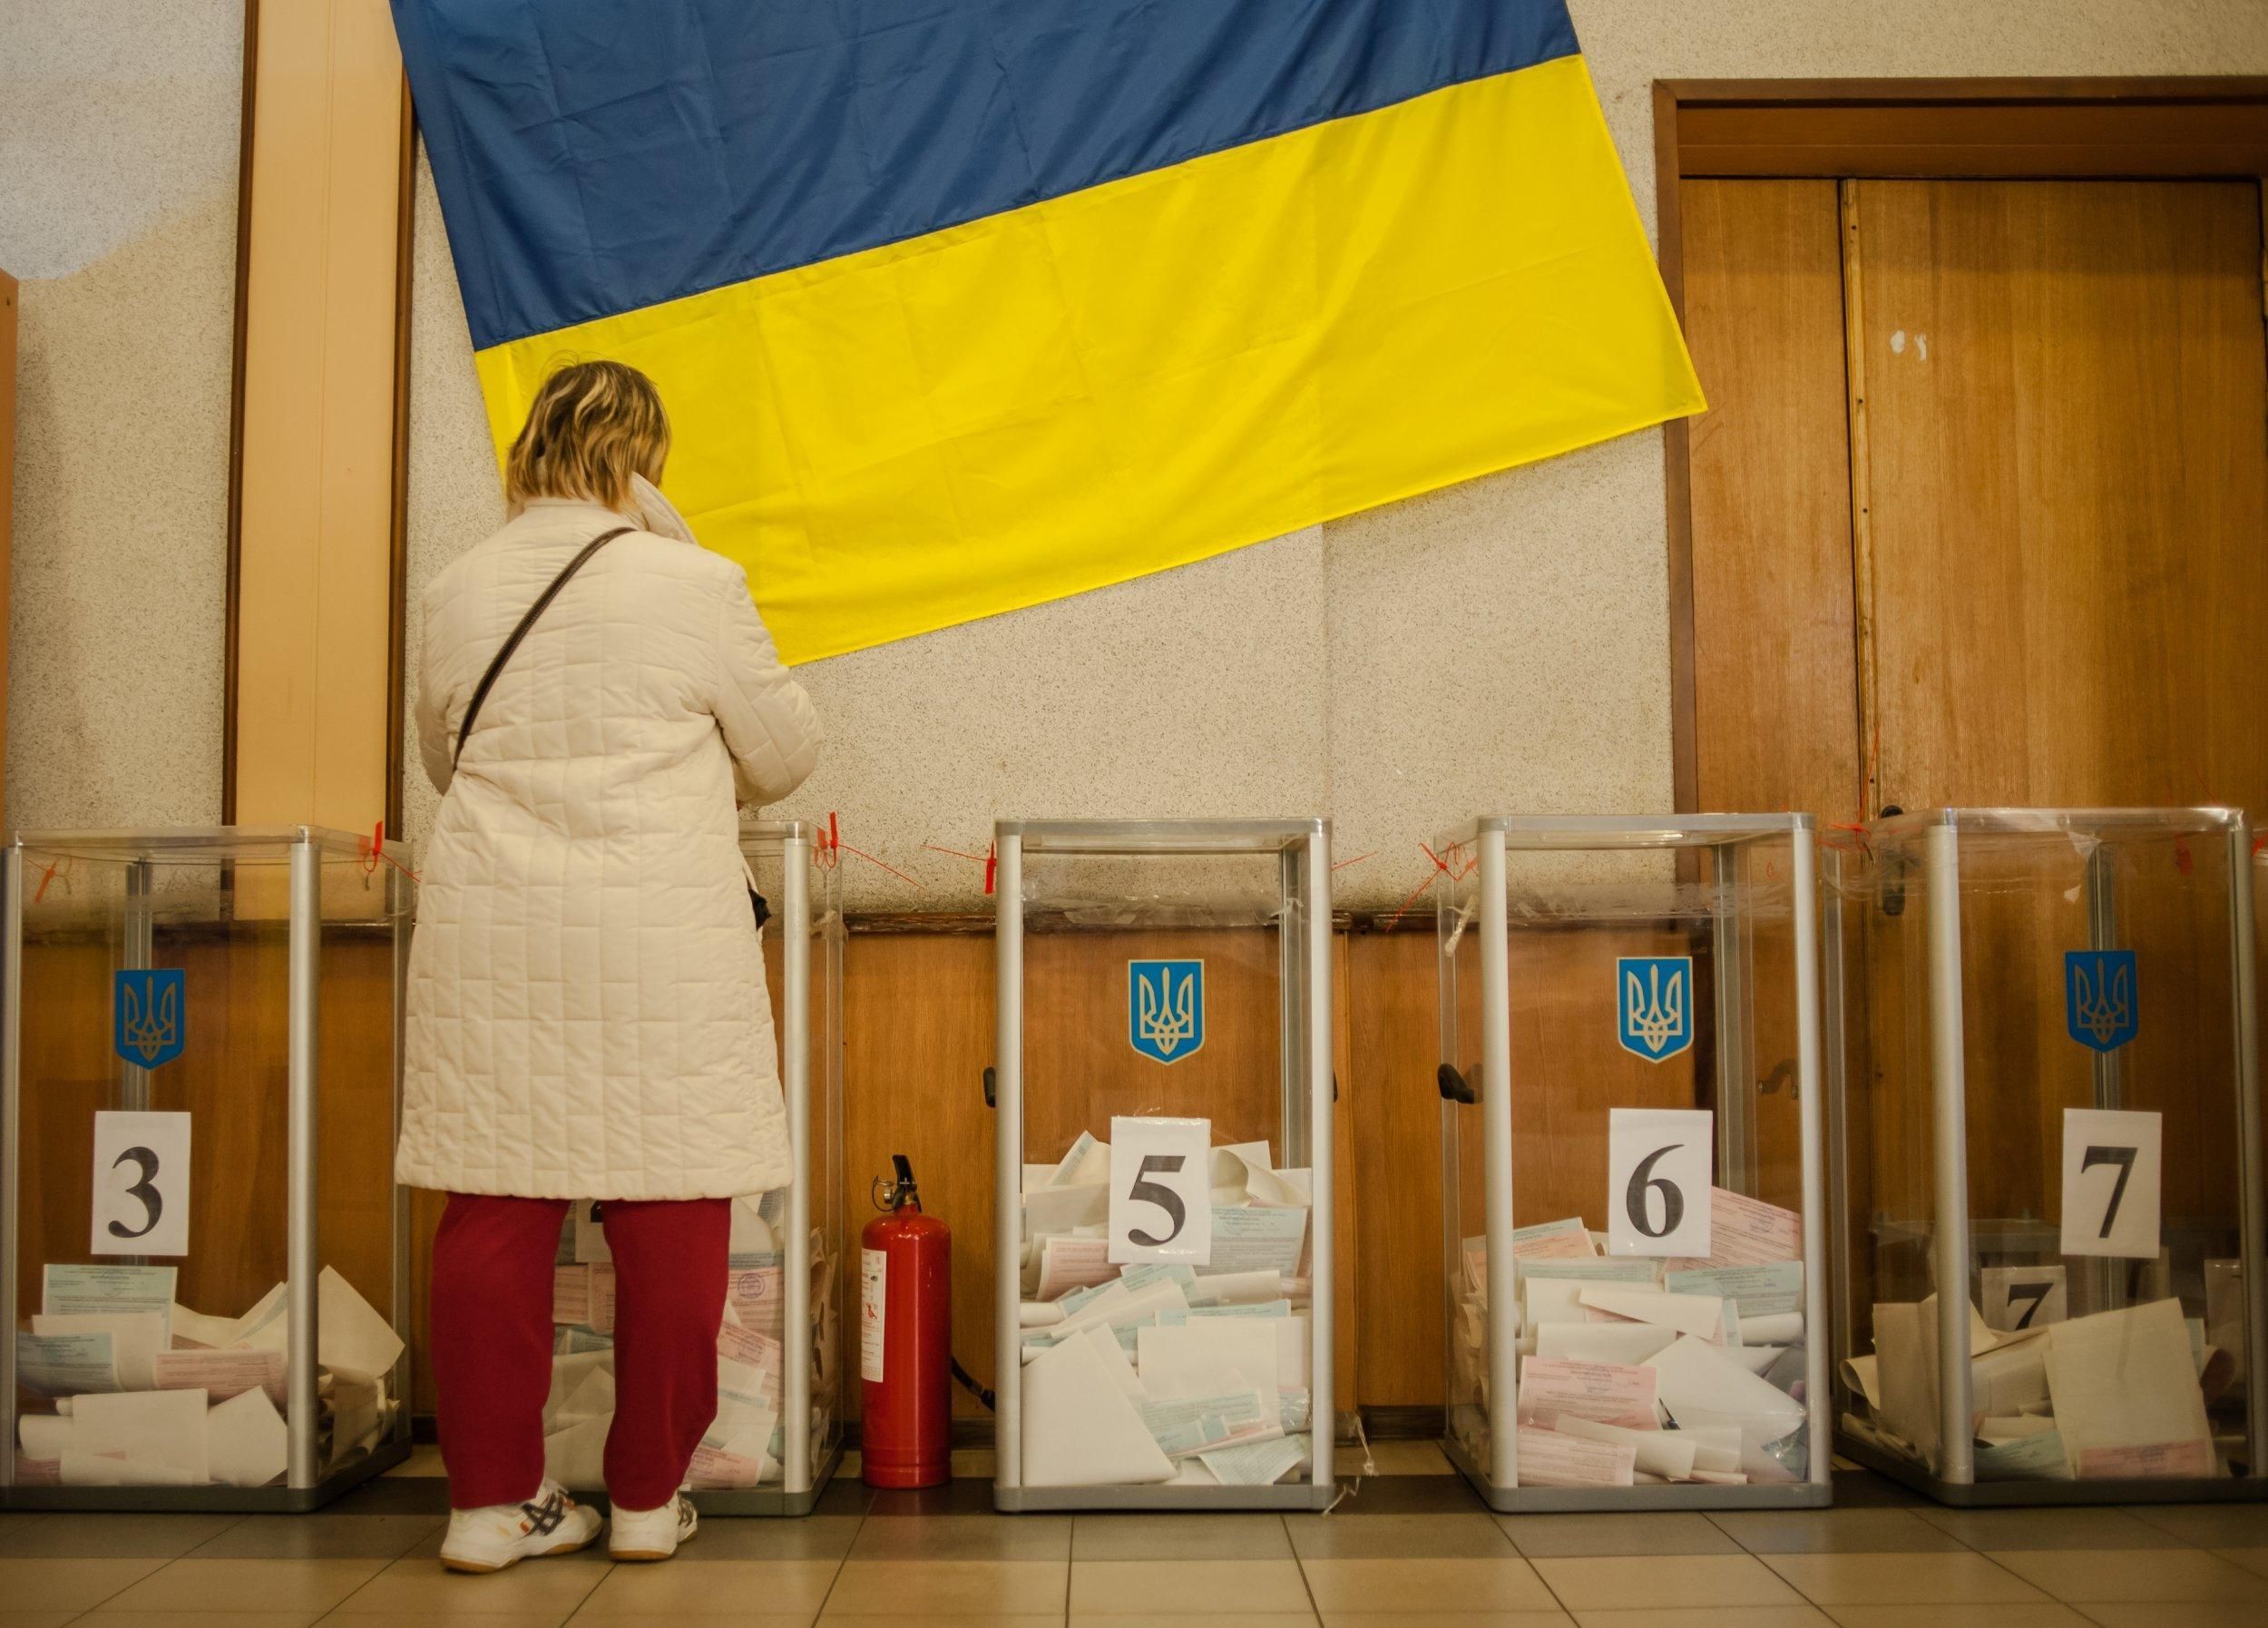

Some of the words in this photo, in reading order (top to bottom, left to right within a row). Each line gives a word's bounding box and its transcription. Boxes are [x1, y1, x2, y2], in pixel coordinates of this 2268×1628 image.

[108, 1147, 162, 1238] 3
[1129, 1155, 1186, 1246] 5
[1627, 1144, 1684, 1237] 6
[2081, 1146, 2137, 1238] 7
[2008, 1283, 2053, 1330] 7
